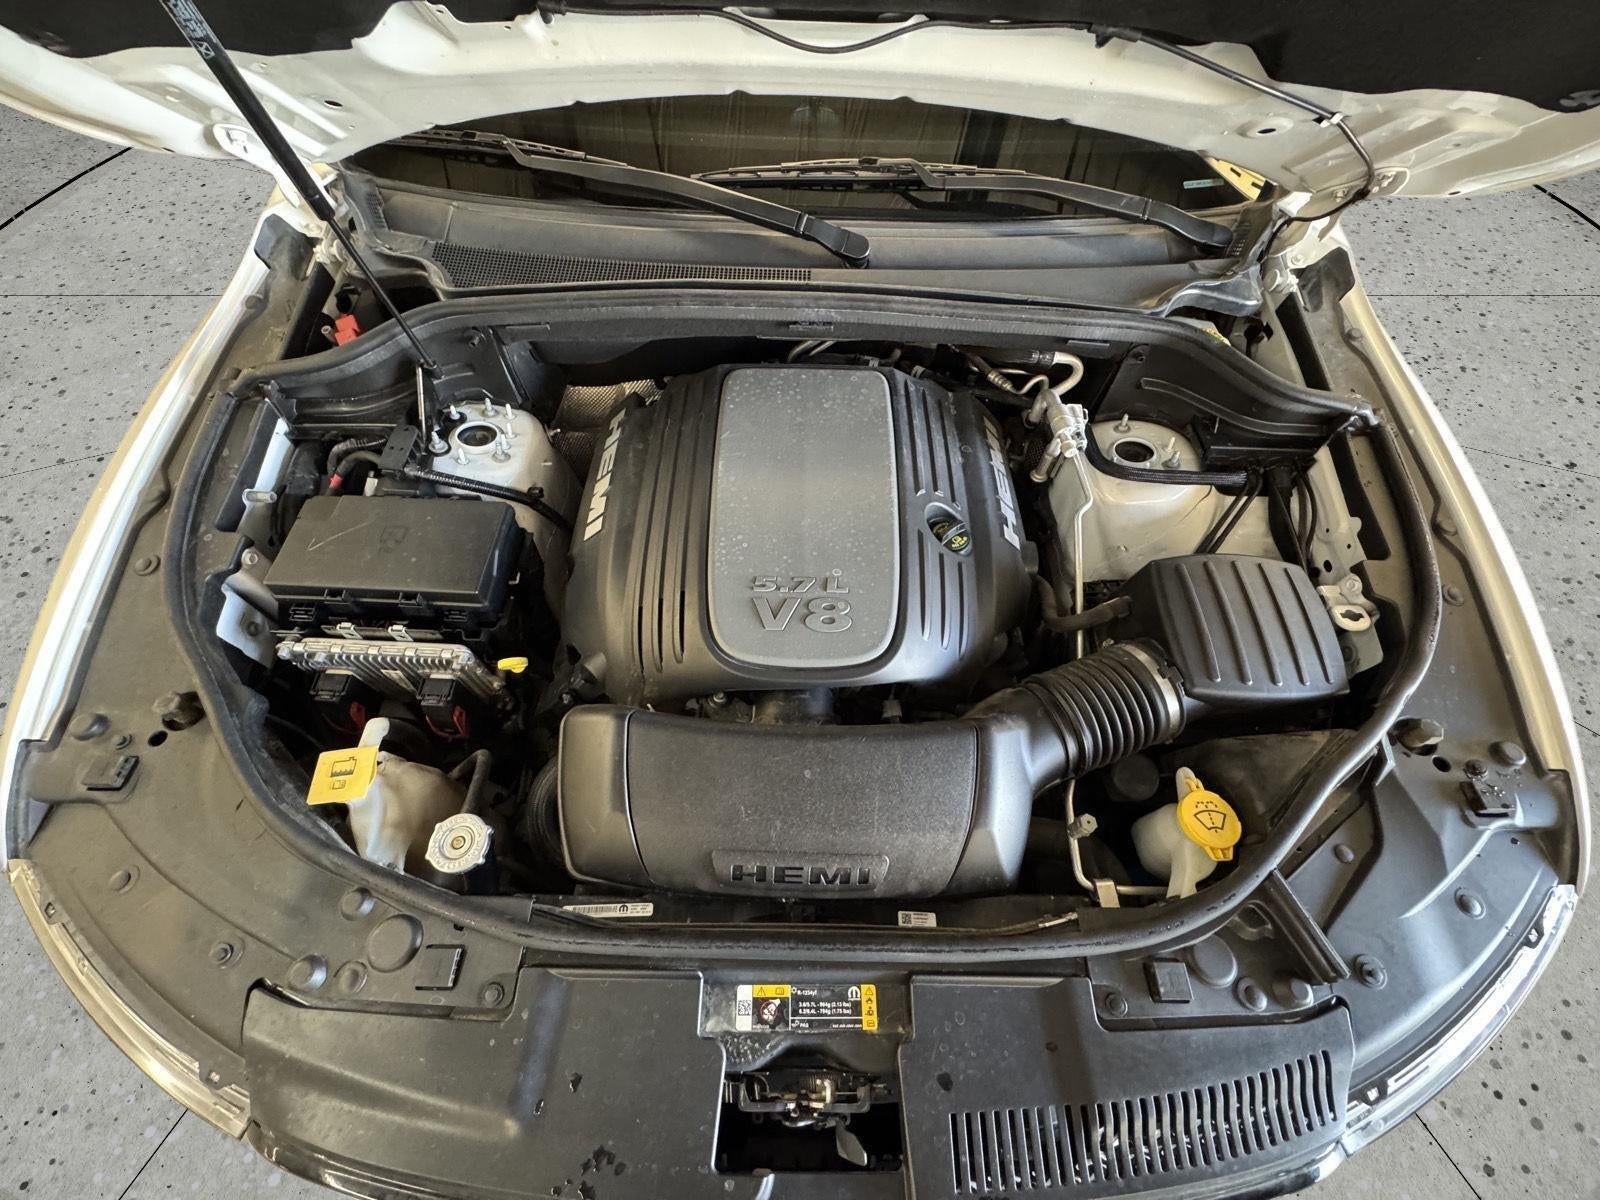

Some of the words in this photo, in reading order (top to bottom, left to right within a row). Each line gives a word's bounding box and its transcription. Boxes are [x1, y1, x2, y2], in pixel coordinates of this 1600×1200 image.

[583, 407, 627, 541] HEMI
[751, 576, 816, 593] 5.7
[823, 577, 849, 593] L
[751, 596, 853, 633] V8
[730, 864, 871, 886] HEMI
